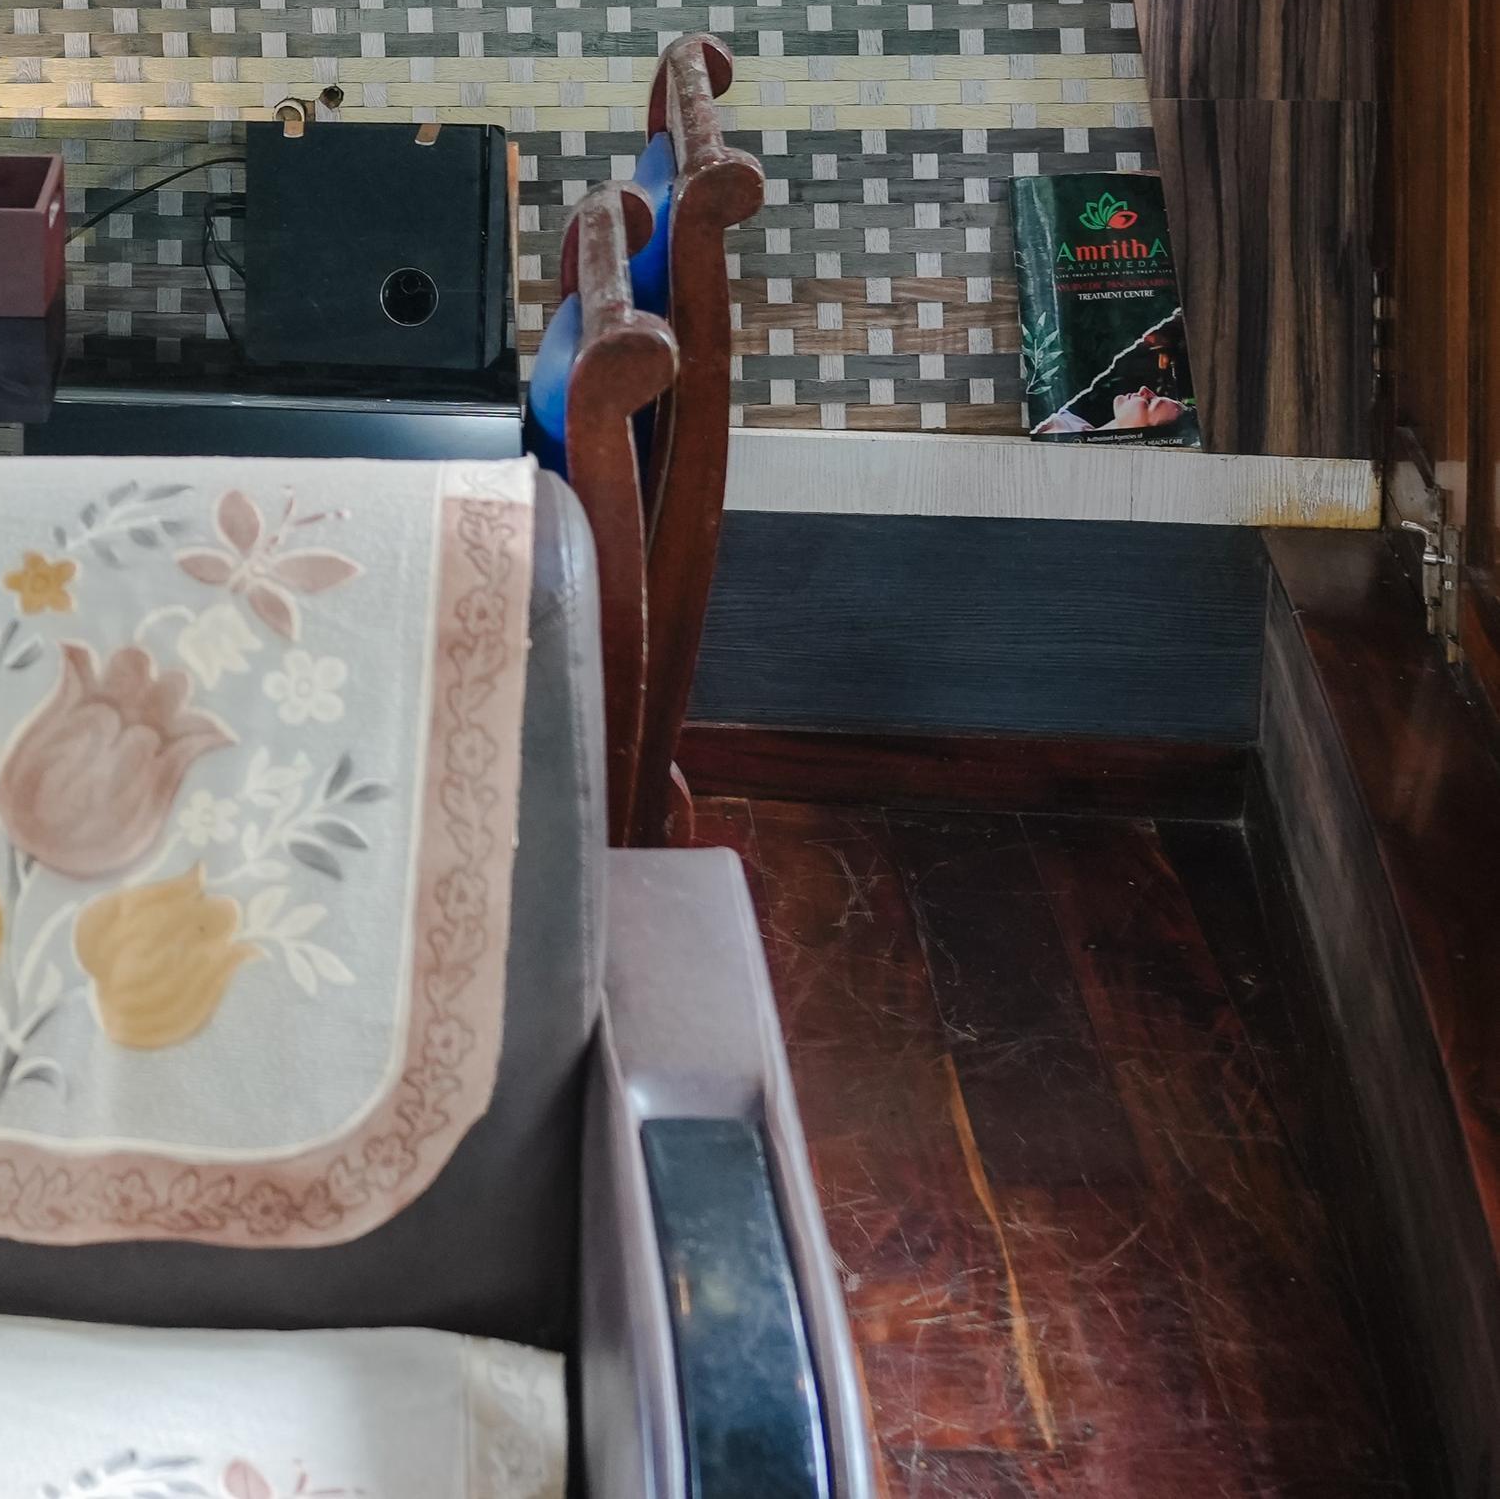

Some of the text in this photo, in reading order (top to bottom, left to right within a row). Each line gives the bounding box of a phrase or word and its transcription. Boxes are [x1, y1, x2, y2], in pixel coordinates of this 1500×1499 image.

[1068, 261, 1158, 271] AYURVEDA
[1078, 290, 1155, 301] TREATMENT CENTRE
